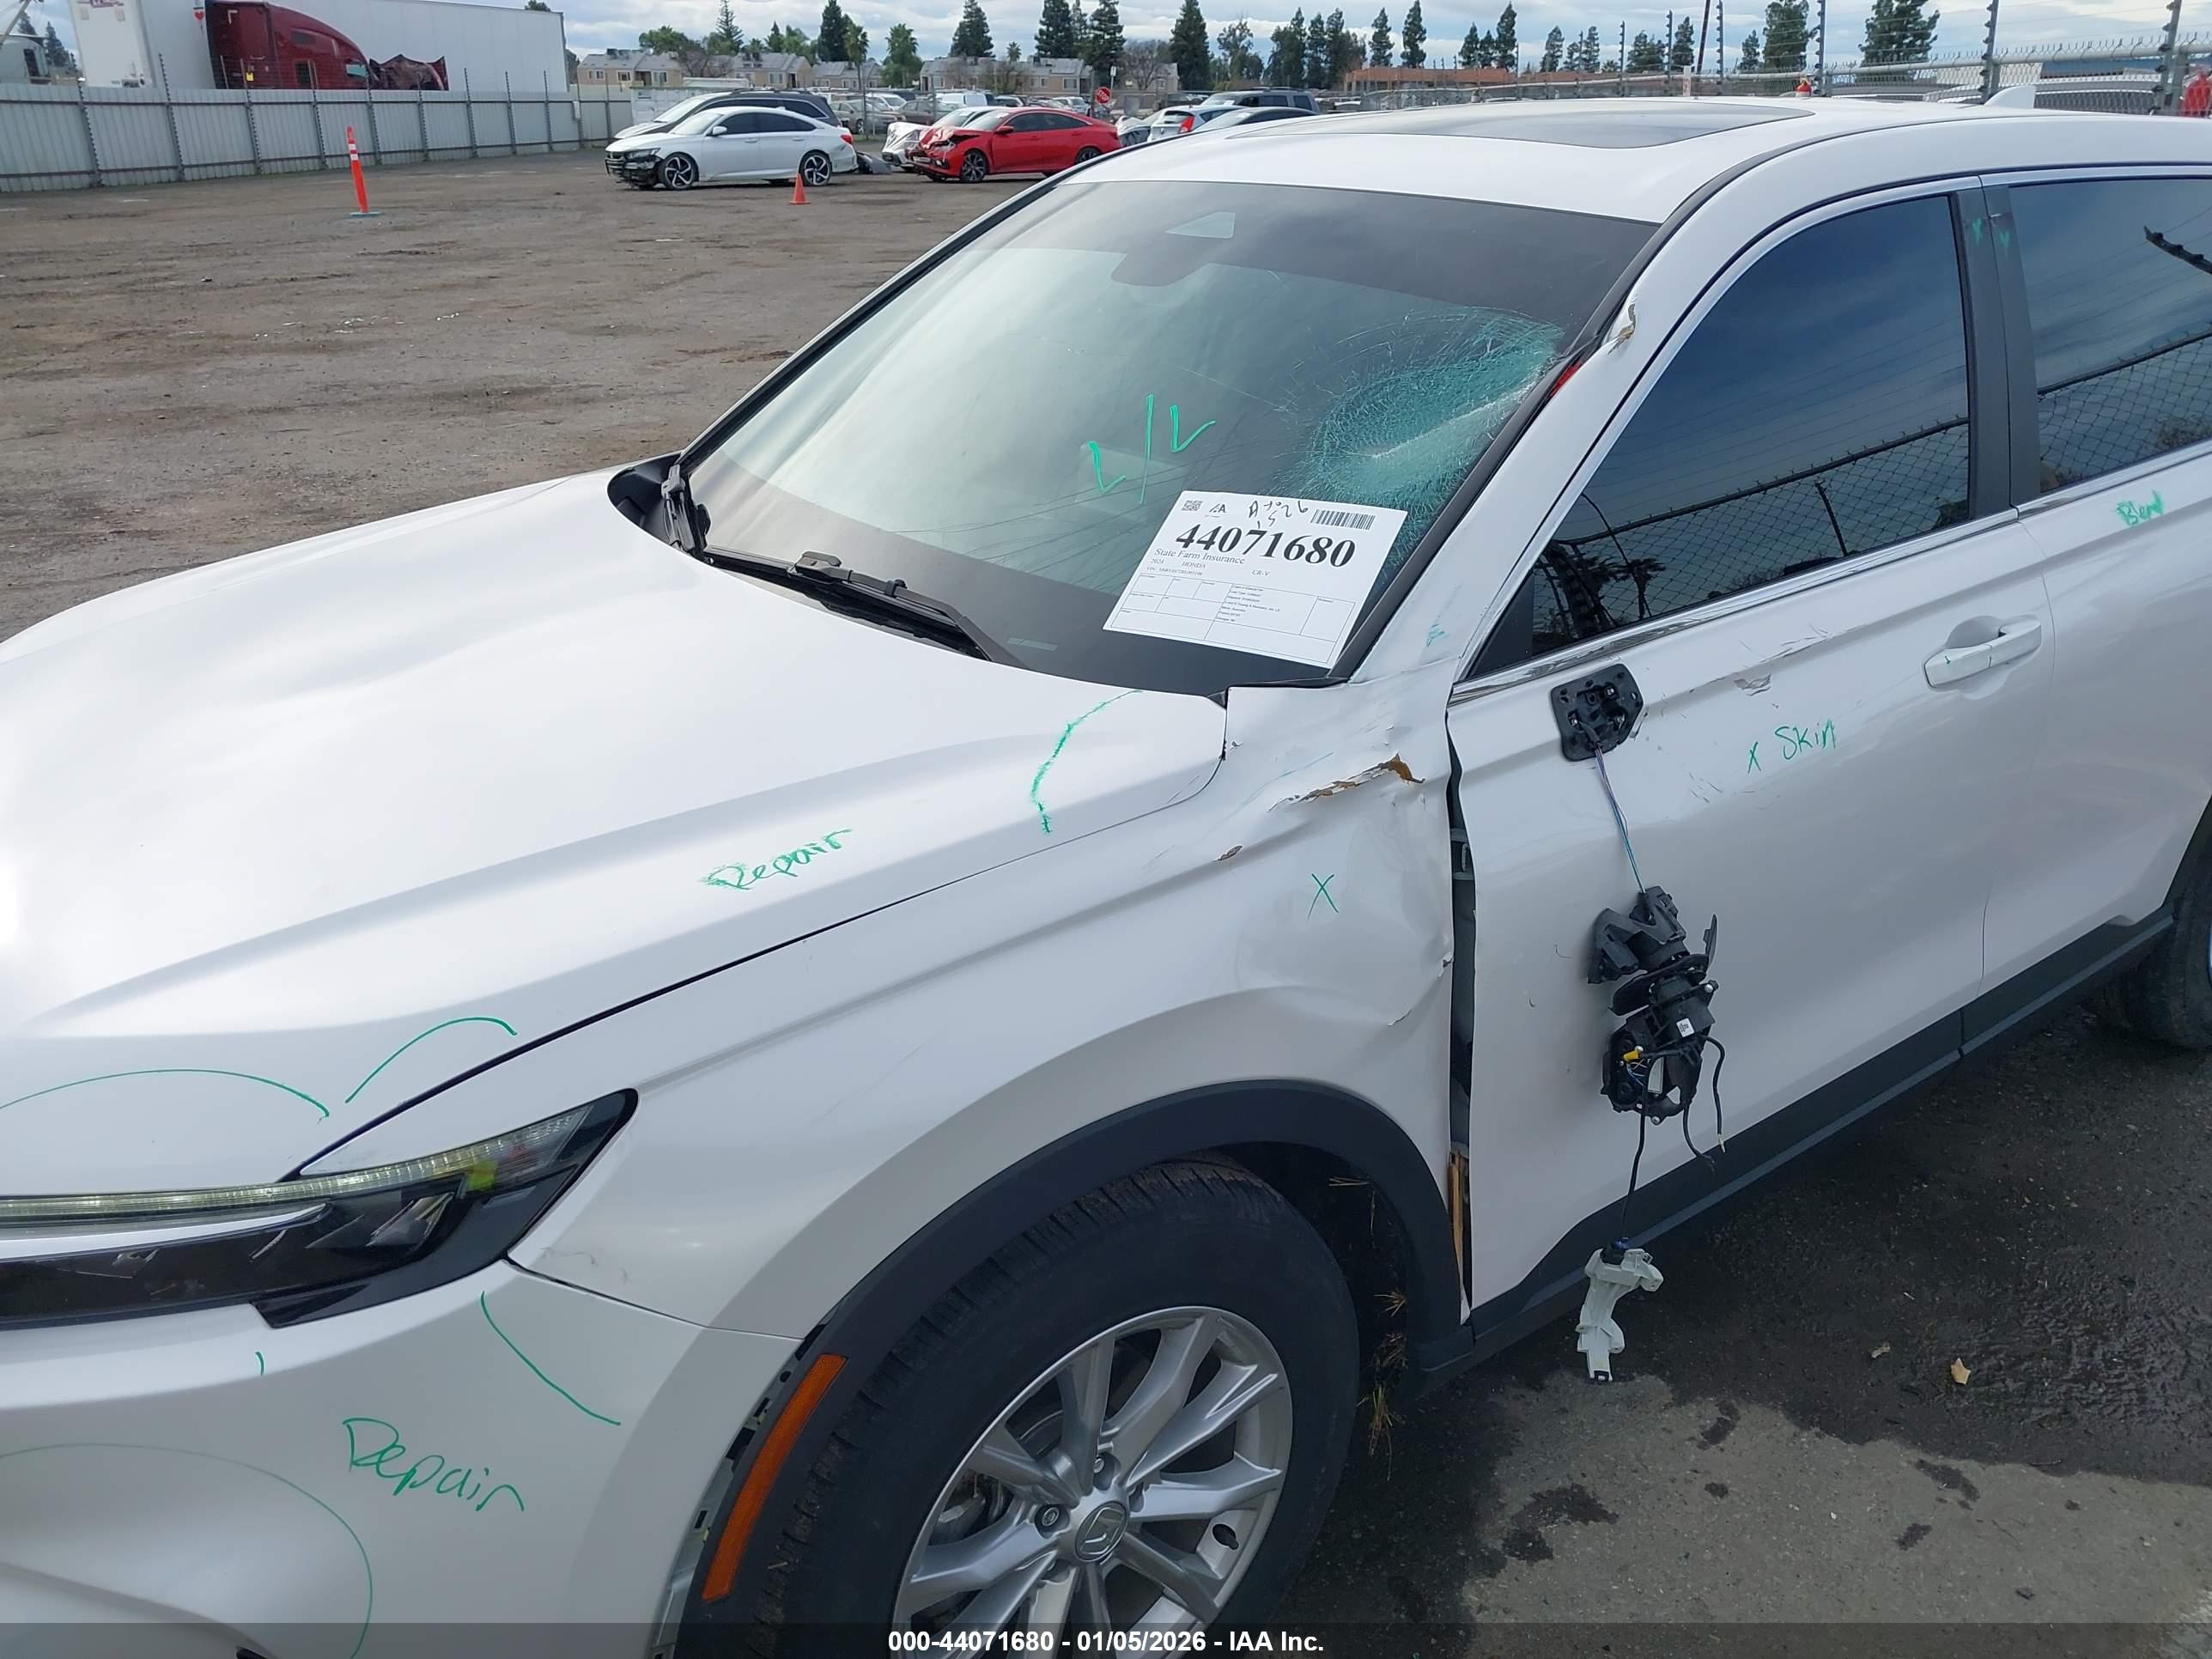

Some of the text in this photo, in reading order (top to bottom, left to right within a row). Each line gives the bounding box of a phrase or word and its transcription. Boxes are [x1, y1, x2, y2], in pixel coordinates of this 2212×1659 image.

[1154, 548, 1245, 564] State Farm Insurance
[1175, 524, 1356, 568] 44071680
[1182, 561, 1206, 569] HONDA
[342, 1417, 525, 1512] Repair
